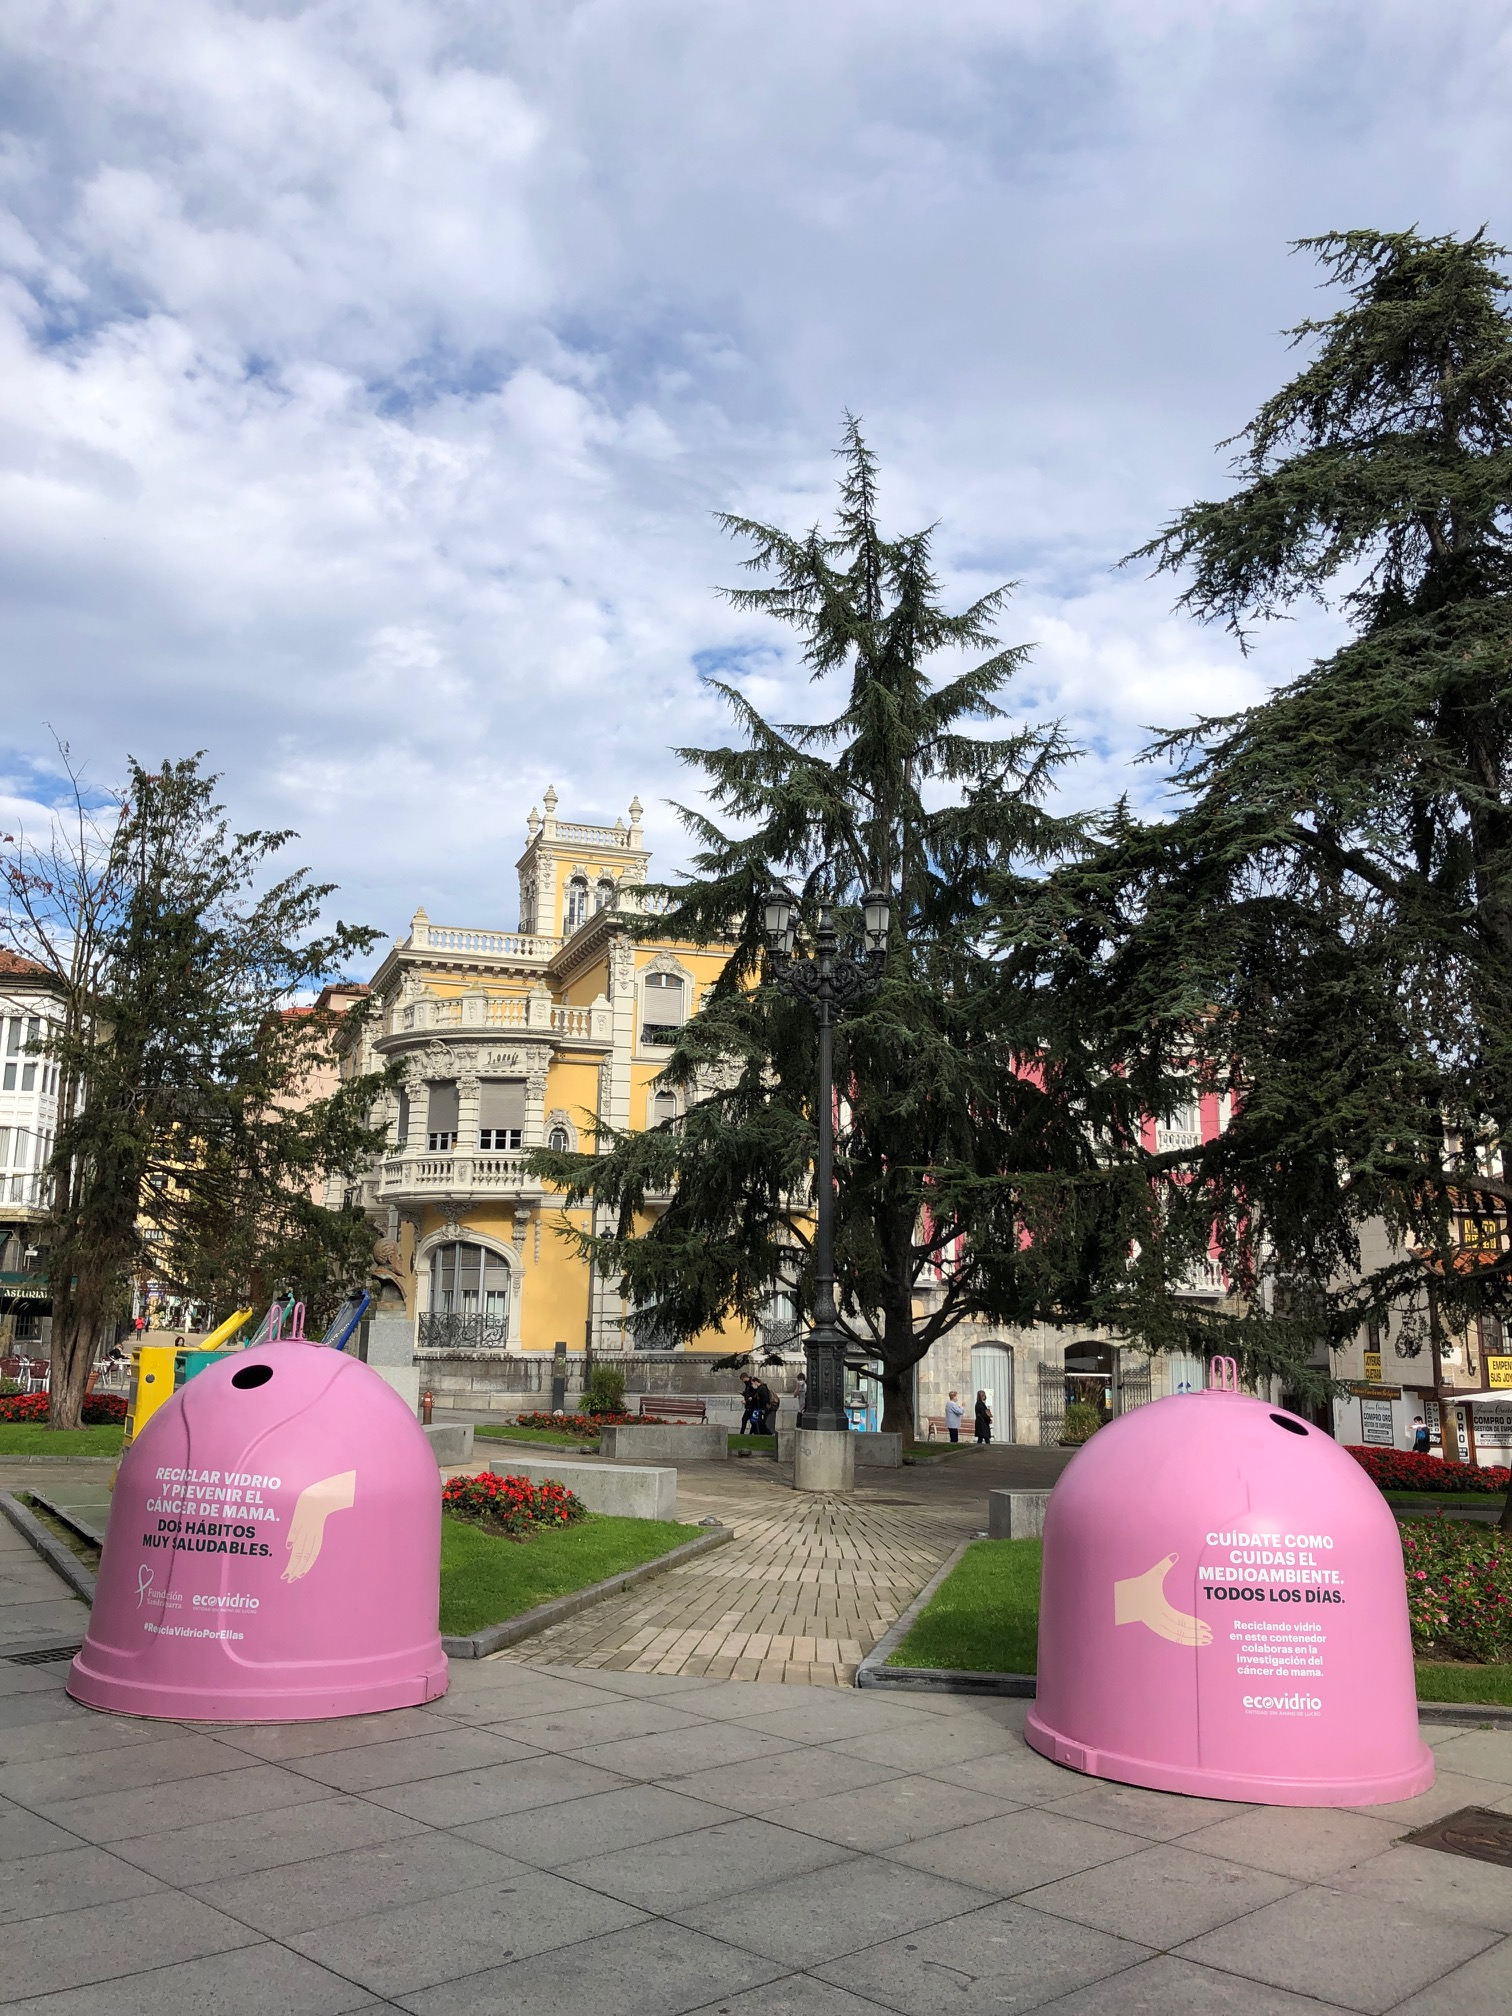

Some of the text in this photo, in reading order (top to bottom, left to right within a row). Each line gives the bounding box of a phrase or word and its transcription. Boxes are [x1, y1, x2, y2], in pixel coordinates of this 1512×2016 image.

[1364, 1413, 1381, 1421] COMPRO
[1457, 1412, 1465, 1443] ORO
[156, 1467, 281, 1490] RECICLAR VIDRIO
[162, 1484, 169, 1496] Y
[246, 1490, 263, 1504] EL
[199, 1503, 219, 1517] DE
[223, 1505, 280, 1522] MAMA.
[158, 1519, 256, 1539] DOS HÁBITOS
[142, 1534, 172, 1548] MUY
[1206, 1530, 1334, 1550] CUÍDATE COMO
[1230, 1550, 1317, 1566] CUIDAS EL
[1199, 1567, 1344, 1584] MEDIOAMBIENTE.
[192, 1593, 260, 1609] ecovidrio
[1203, 1586, 1345, 1604] TODOS LOS DÍAS.
[1234, 1620, 1322, 1632] Reciclando vidrio
[1245, 1633, 1267, 1642] este
[1270, 1633, 1326, 1643] contenedor
[1241, 1644, 1293, 1654] colaboras
[1308, 1645, 1317, 1654] la
[1236, 1655, 1323, 1667] investigación del
[1237, 1666, 1324, 1677] cáncer de mama.
[1242, 1693, 1322, 1710] ecovidrio
